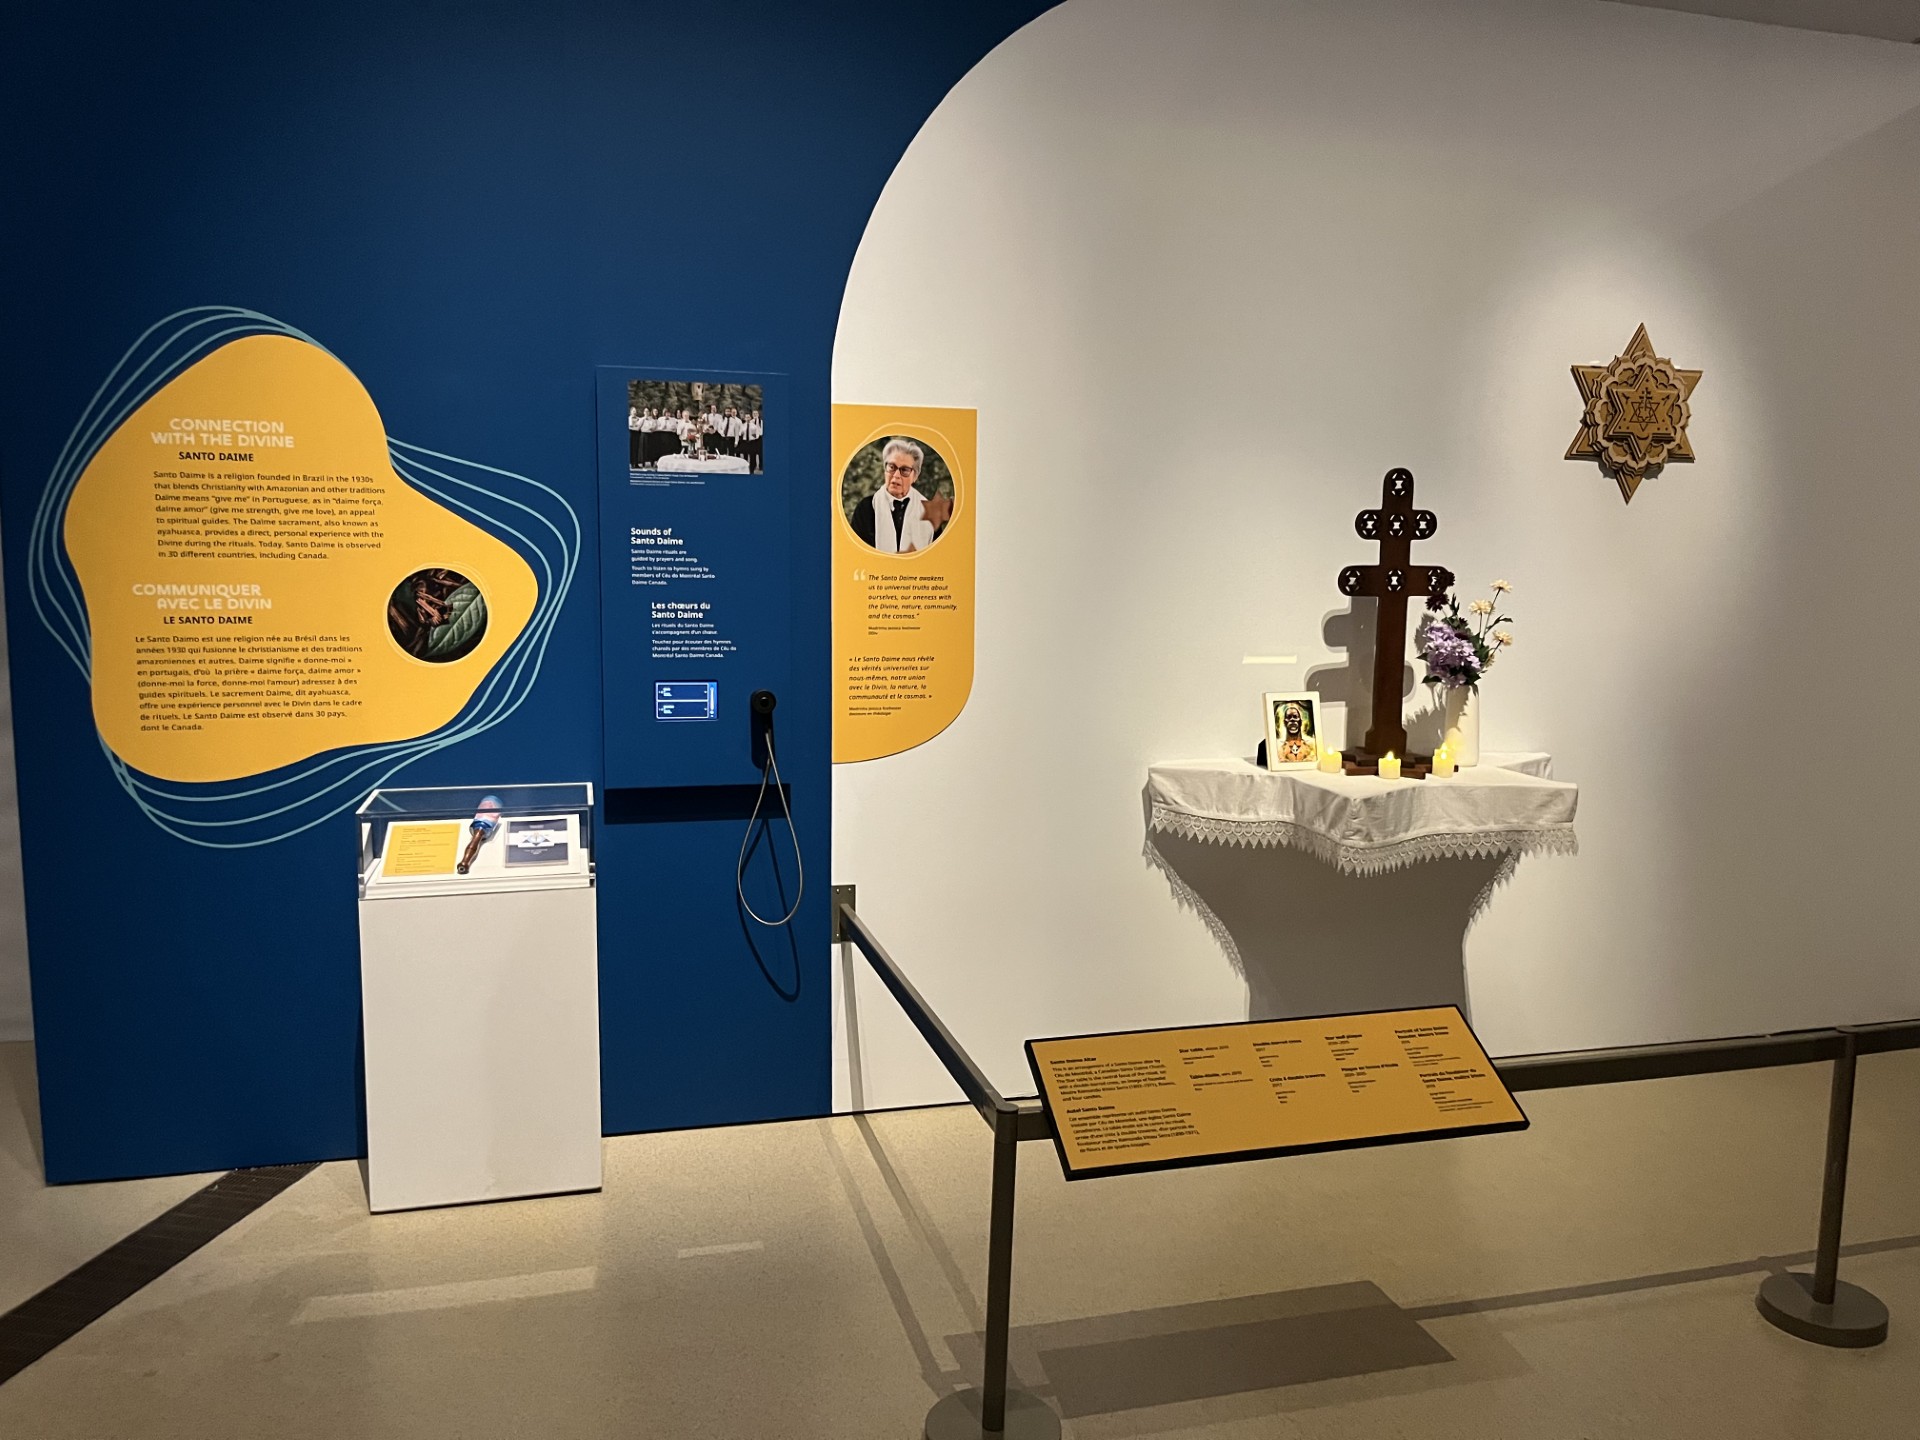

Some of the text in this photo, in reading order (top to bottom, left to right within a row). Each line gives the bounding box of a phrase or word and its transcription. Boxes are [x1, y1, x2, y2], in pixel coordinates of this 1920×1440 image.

[170, 418, 285, 434] CONNECTION
[151, 432, 294, 448] WITH THE DIVINE
[178, 451, 254, 462] SANTO DAIME
[153, 470, 178, 479] Santo
[179, 471, 207, 480] Daime
[207, 472, 215, 480] is
[223, 472, 255, 482] religion
[257, 473, 291, 481] founded
[292, 474, 301, 482] in
[302, 474, 325, 482] Brazil
[335, 475, 350, 483] the
[351, 475, 374, 484] 1930s
[154, 482, 172, 490] that
[172, 482, 200, 491] blends
[201, 483, 247, 493] Christianity
[247, 484, 265, 492] with
[266, 485, 310, 493] Amazonian
[326, 486, 349, 494] other
[349, 486, 386, 494] traditions
[155, 505, 182, 513] daime
[209, 506, 230, 515] (give
[283, 508, 300, 517] give
[349, 508, 376, 518] appeal
[166, 517, 200, 526] spiritual
[232, 517, 249, 526] The
[249, 518, 277, 526] Daime
[324, 519, 341, 527] also
[342, 519, 369, 527] known
[204, 529, 239, 537] provides
[273, 529, 309, 539] personal
[309, 530, 352, 539] experience
[631, 527, 672, 536] Sounds of
[157, 539, 183, 547] Divine
[184, 539, 212, 549] during
[212, 539, 227, 548] the
[285, 541, 309, 549] Santo
[310, 541, 336, 549] Daime
[337, 541, 345, 549] is
[345, 541, 382, 549] observed
[631, 536, 684, 546] Santo Daime
[167, 550, 179, 558] 30
[180, 550, 216, 559] different
[259, 551, 296, 561] including
[881, 574, 898, 582] Santo
[132, 584, 261, 598] COMMUNIQUER
[157, 599, 272, 610] AVEC LE DIVIN
[651, 602, 711, 610] Les chœurs du
[651, 610, 704, 619] Santo Daime
[163, 616, 253, 625] LE SANTO DAIME
[146, 635, 171, 643] Santo
[233, 635, 265, 644] religion
[265, 634, 282, 643] née
[294, 635, 317, 643] Brésil
[339, 634, 351, 642] les
[140, 724, 160, 732] dont
